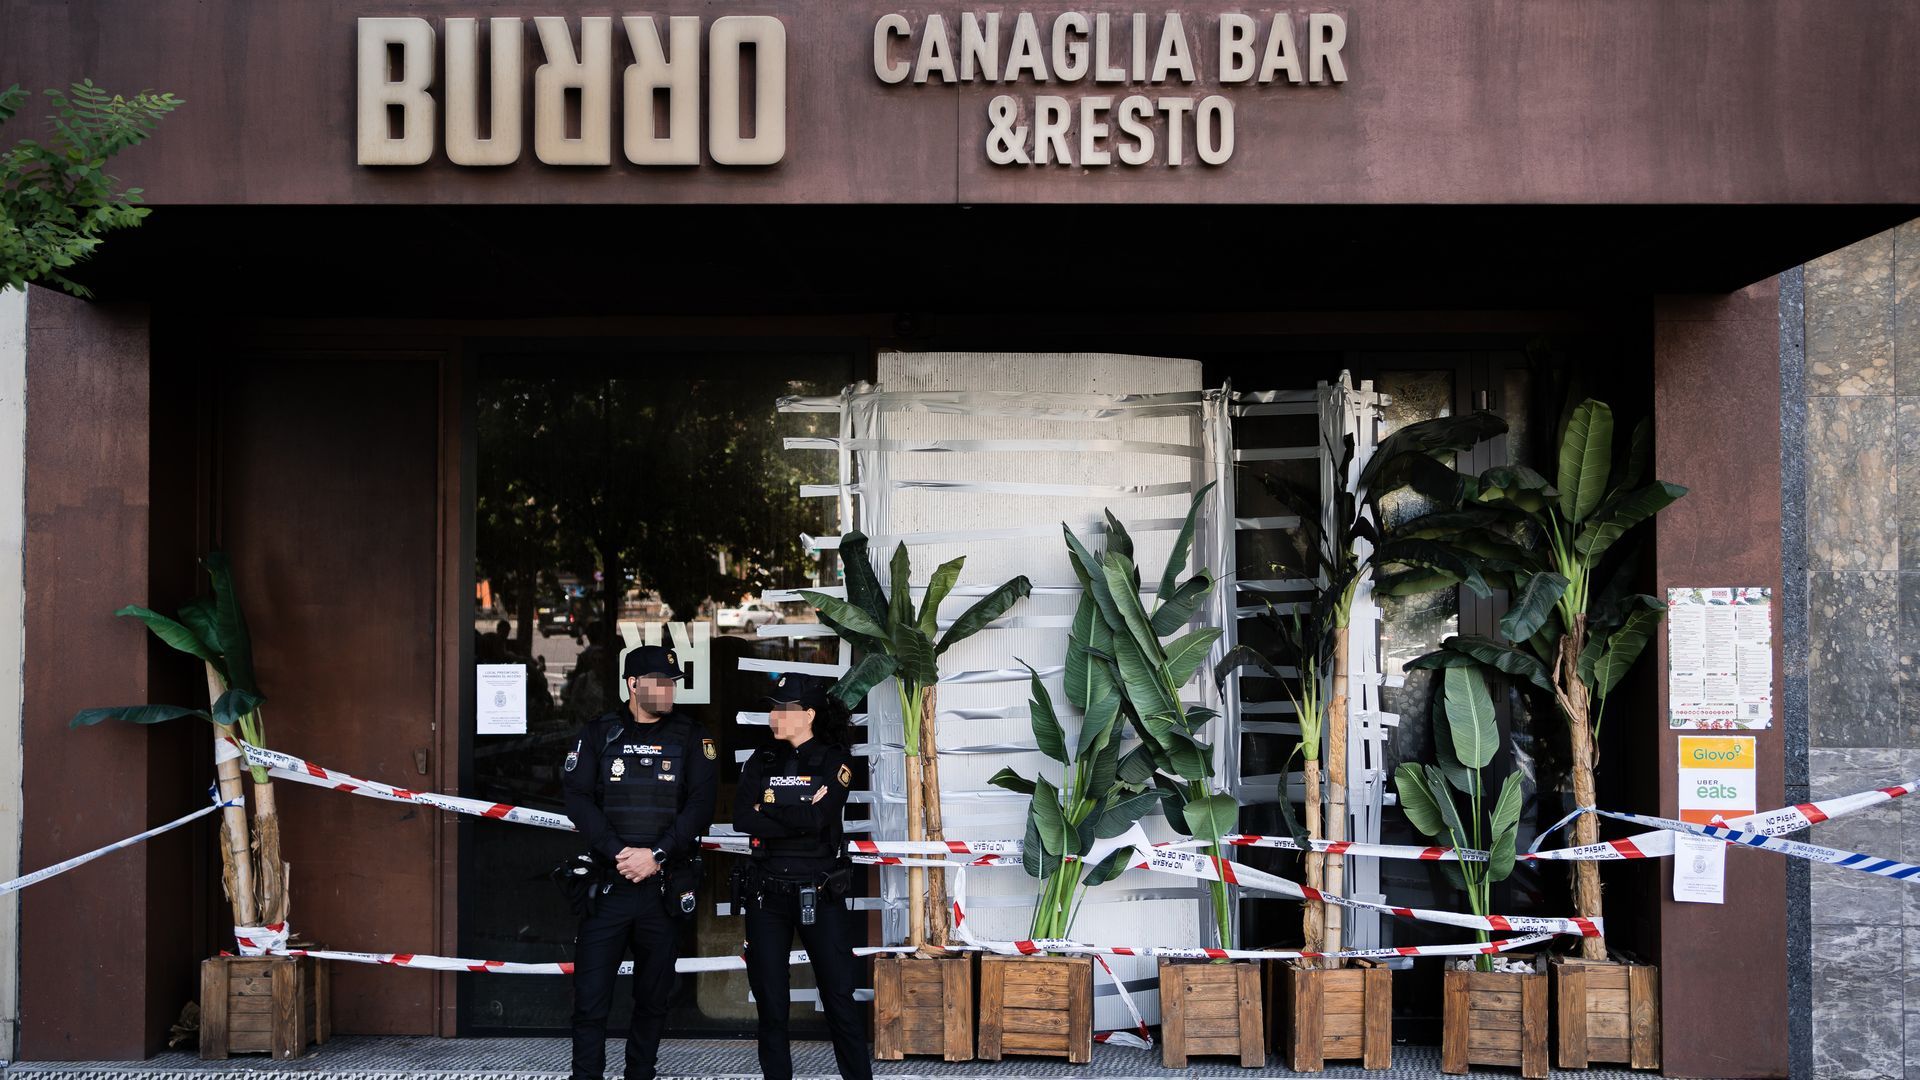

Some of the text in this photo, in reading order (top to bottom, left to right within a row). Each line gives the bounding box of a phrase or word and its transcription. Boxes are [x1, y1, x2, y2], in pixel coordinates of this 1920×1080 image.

[873, 11, 1348, 84] CANAGLIA BAR
[985, 94, 1235, 167] &RESTO
[1693, 748, 1735, 760] Glovo
[1696, 784, 1737, 798] eats
[1765, 812, 1797, 826] NO PASAR
[1776, 825, 1786, 834] DE
[973, 843, 1004, 851] NO PASAR
[1584, 845, 1607, 853] PASAR
[1167, 851, 1177, 859] DE
[1178, 853, 1195, 862] LINEA
[1152, 859, 1184, 869] NO PASAR
